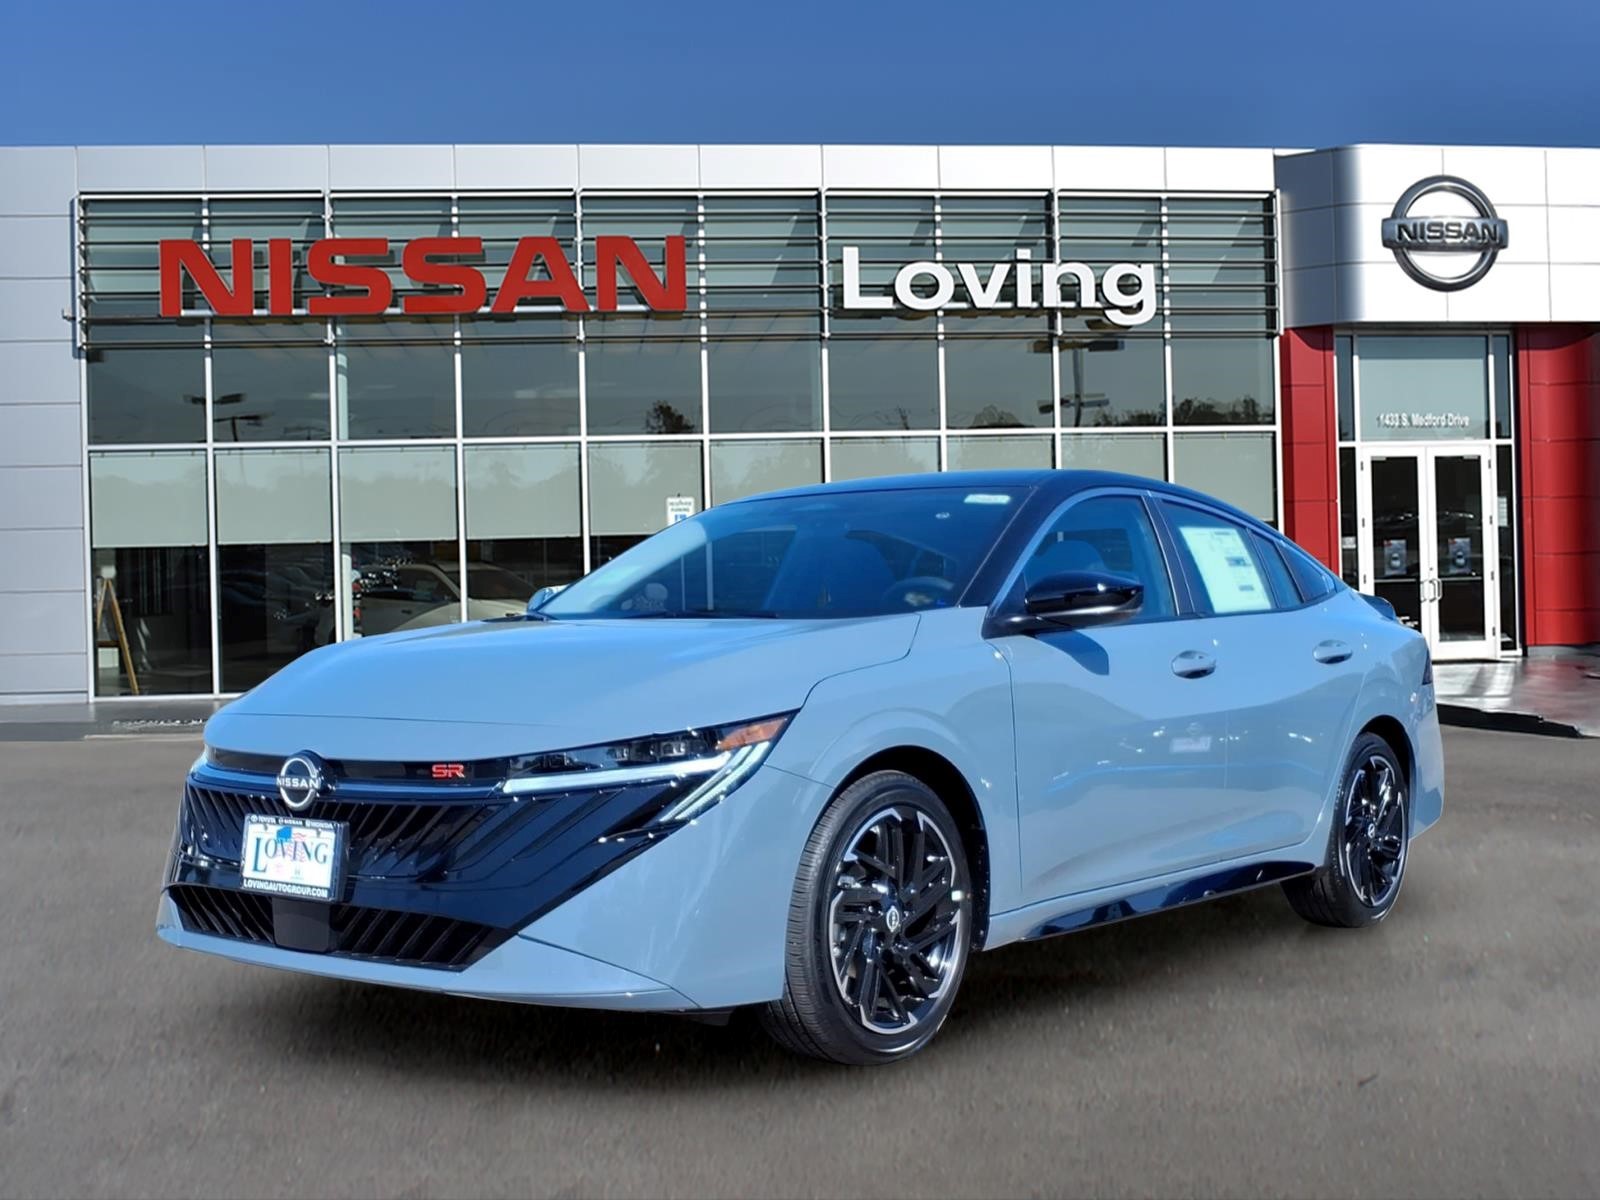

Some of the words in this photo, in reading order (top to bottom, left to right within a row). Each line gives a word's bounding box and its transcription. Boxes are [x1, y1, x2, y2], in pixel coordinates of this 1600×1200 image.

[1397, 222, 1498, 242] NISSAN
[159, 235, 687, 317] NISSAN
[843, 246, 1157, 326] Loving
[1447, 412, 1470, 427] Drive
[431, 764, 465, 778] SR
[276, 776, 320, 789] NISSAN
[252, 837, 329, 873] LOVING
[243, 879, 329, 898] LOVINGAUTOGROUP.COM
